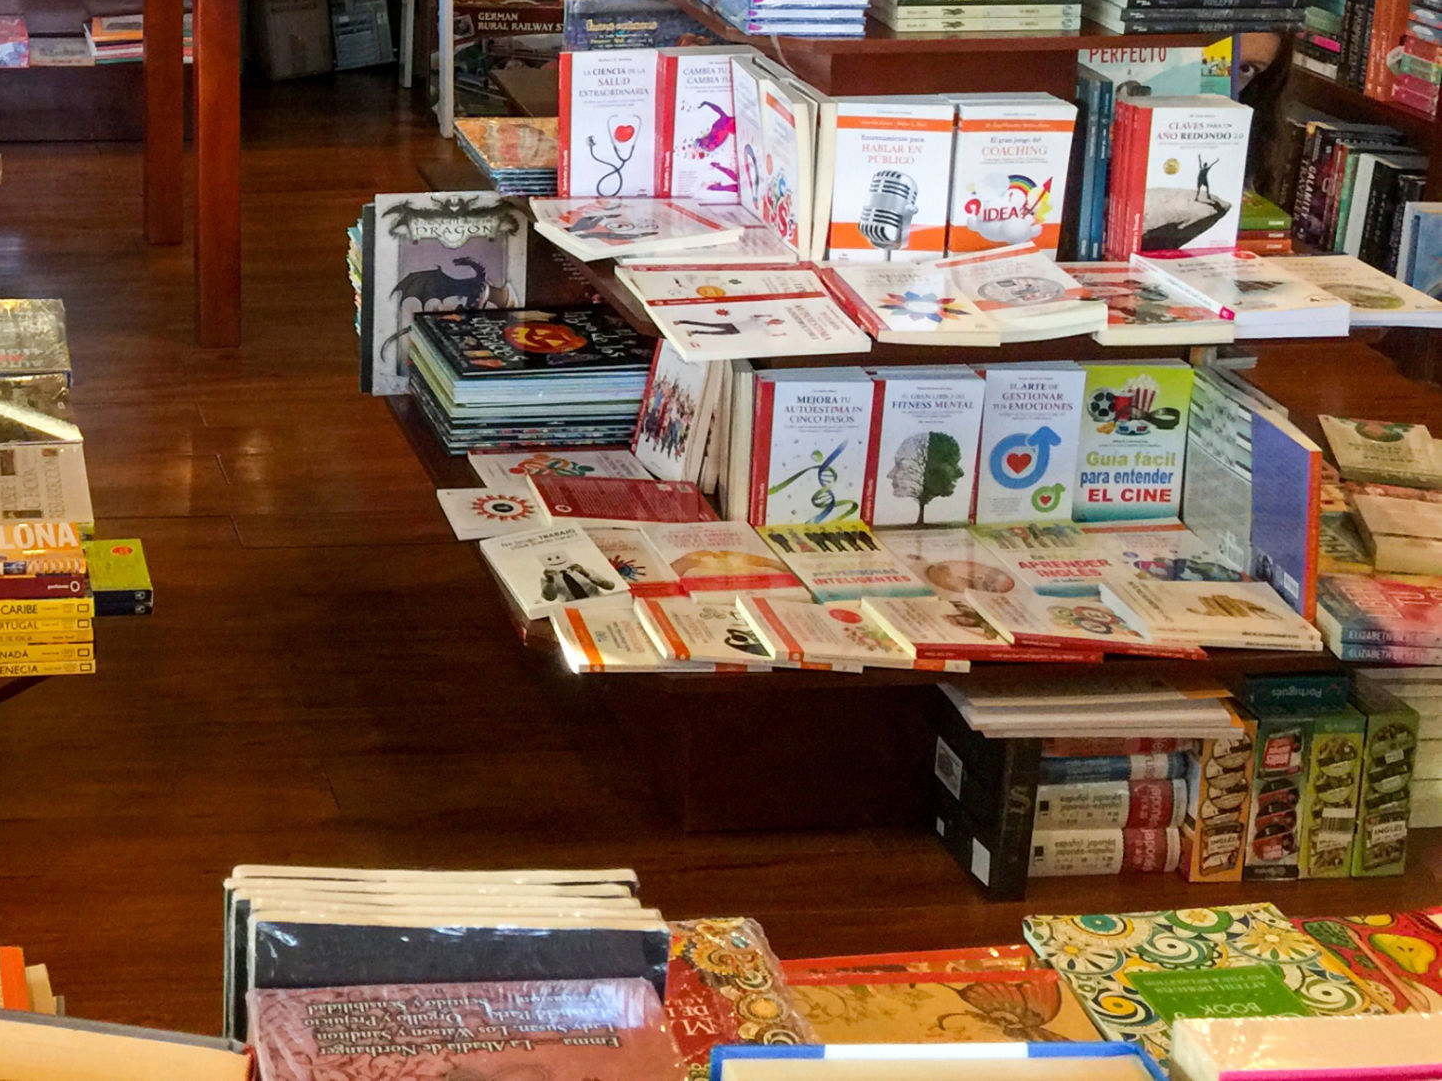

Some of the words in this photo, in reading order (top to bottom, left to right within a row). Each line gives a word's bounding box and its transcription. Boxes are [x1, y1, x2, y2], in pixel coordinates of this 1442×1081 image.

[478, 12, 519, 22] GERMAN
[478, 22, 509, 31] RURAL
[511, 22, 553, 32] RAILWAY
[1089, 47, 1167, 64] PERFECTO
[592, 68, 626, 76] CIENCIA
[683, 67, 716, 76] CAMBIA
[598, 77, 631, 86] SALUD
[687, 76, 720, 85] CAMBIA
[579, 88, 650, 97] EXTRAORDINARIA
[1168, 122, 1204, 130] CLAVES
[1157, 131, 1178, 140] AÑO
[1180, 132, 1232, 140] REDONDO
[862, 144, 905, 154] HABLAR
[908, 145, 923, 154] EN
[982, 145, 1048, 156] COACHING
[867, 154, 915, 165] PÚBLICO
[1021, 382, 1047, 391] ARTE
[797, 395, 838, 404] MEJORA
[1002, 392, 1063, 401] GESTIONAR
[784, 405, 851, 414] AUTOESTIMA
[892, 401, 932, 409] FITNESS
[935, 401, 974, 409] MENTAL
[1008, 402, 1073, 411] EMOCIONES
[790, 415, 822, 423] CINCO
[824, 415, 855, 423] PASOS
[1086, 451, 1128, 467] Guía
[1135, 451, 1176, 466] fácil
[1080, 470, 1109, 488] para
[1114, 468, 1174, 484] entender
[1088, 488, 1113, 502] EL
[1120, 488, 1172, 502] CINE
[1018, 558, 1112, 569] APRENDER
[0, 604, 38, 614] CARIBE
[1349, 629, 1393, 642] ELIZABETH
[1349, 647, 1393, 660] ELIZABETH
[307, 1000, 406, 1015] Sensibilidad
[427, 998, 488, 1011] Sentido
[1197, 1001, 1263, 1016] BOOK
[304, 1015, 377, 1029] Prejuicio
[396, 1011, 461, 1025] Orgullo
[316, 1030, 391, 1042] Sanditon
[412, 1026, 471, 1039] Watson
[479, 1025, 507, 1037] Los
[446, 1040, 506, 1055] Abadía
[510, 1039, 533, 1051] La
[563, 1036, 620, 1048] Emma
[318, 1042, 417, 1056] Northanger
[423, 1042, 442, 1055] de
